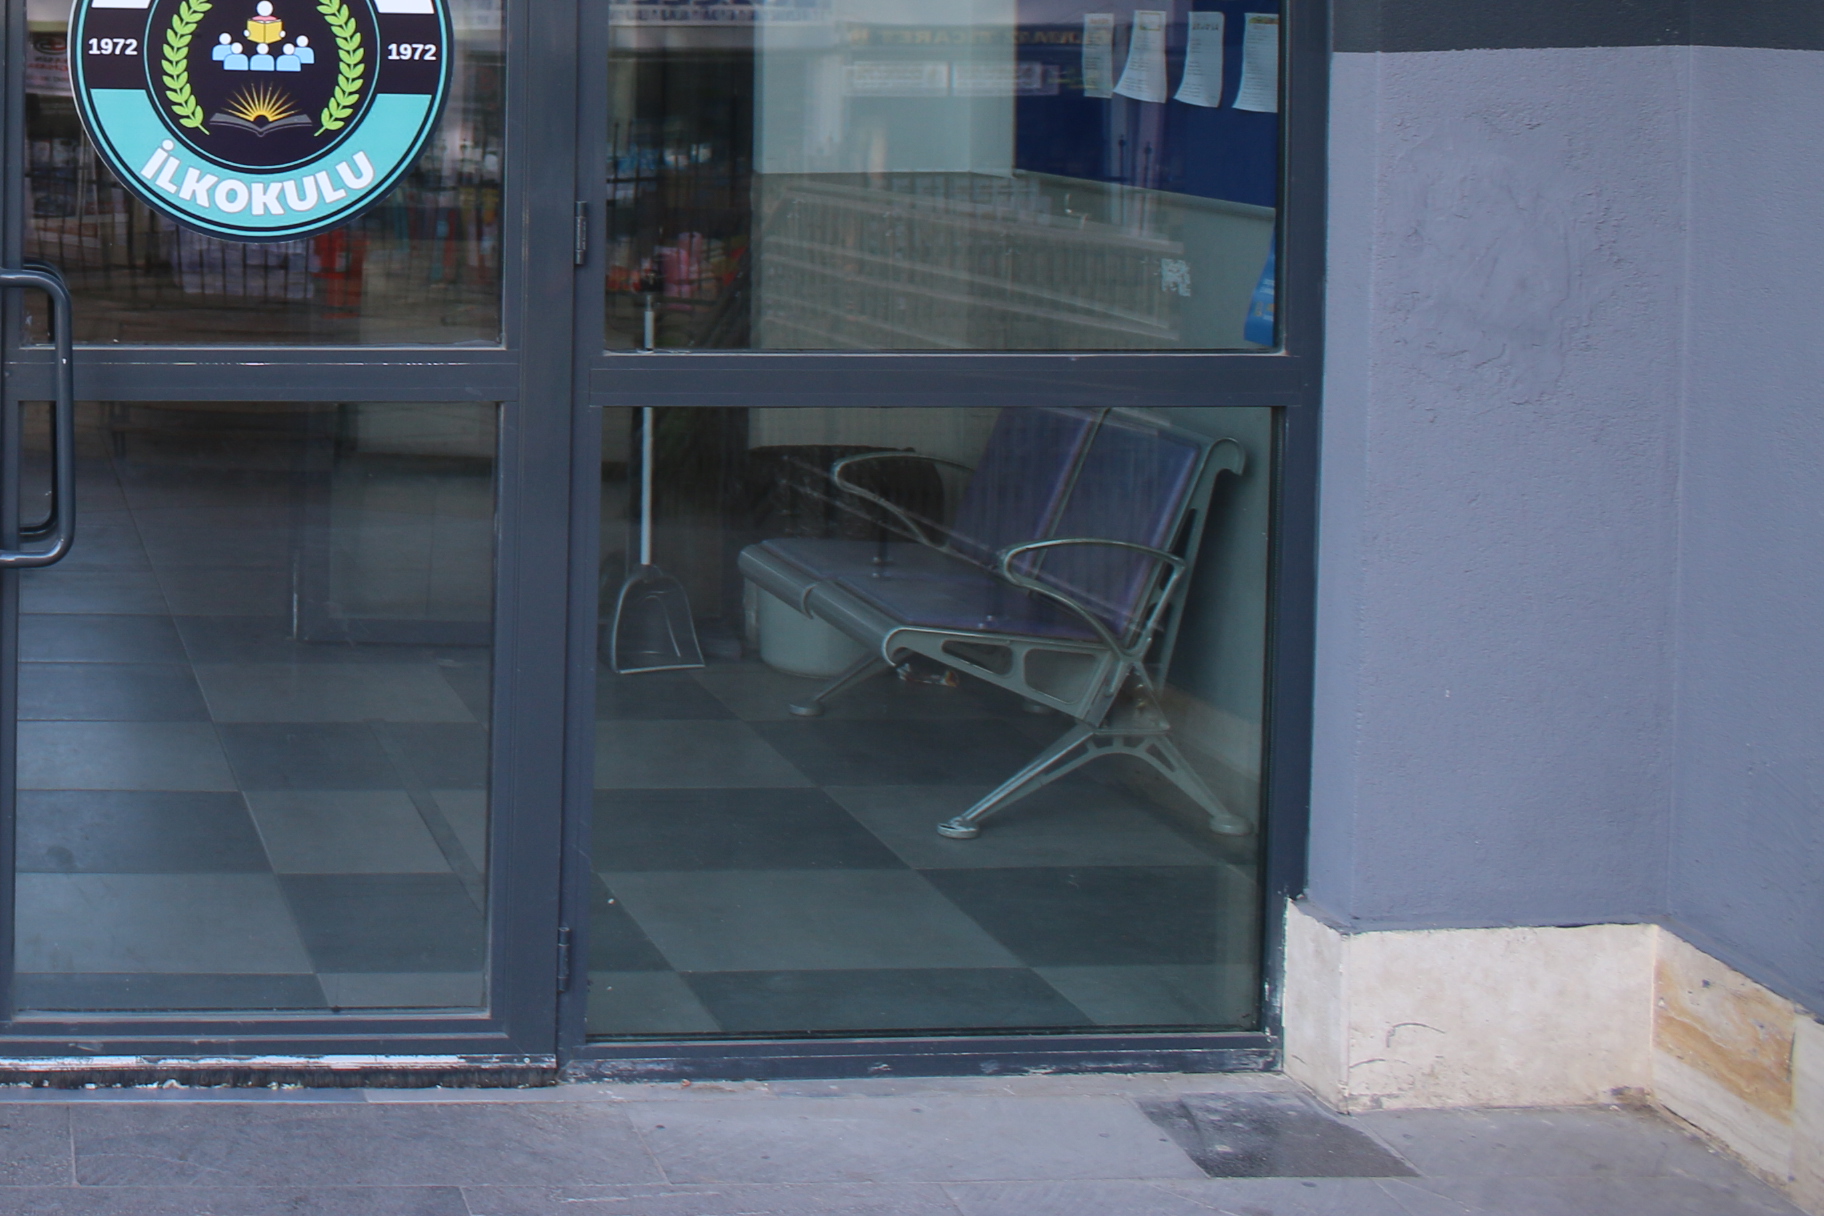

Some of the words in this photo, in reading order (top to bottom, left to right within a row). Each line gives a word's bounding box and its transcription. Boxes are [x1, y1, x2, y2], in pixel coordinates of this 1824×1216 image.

[88, 37, 138, 55] 1972
[388, 43, 437, 61] 1972
[140, 139, 375, 215] İLKOKULU
